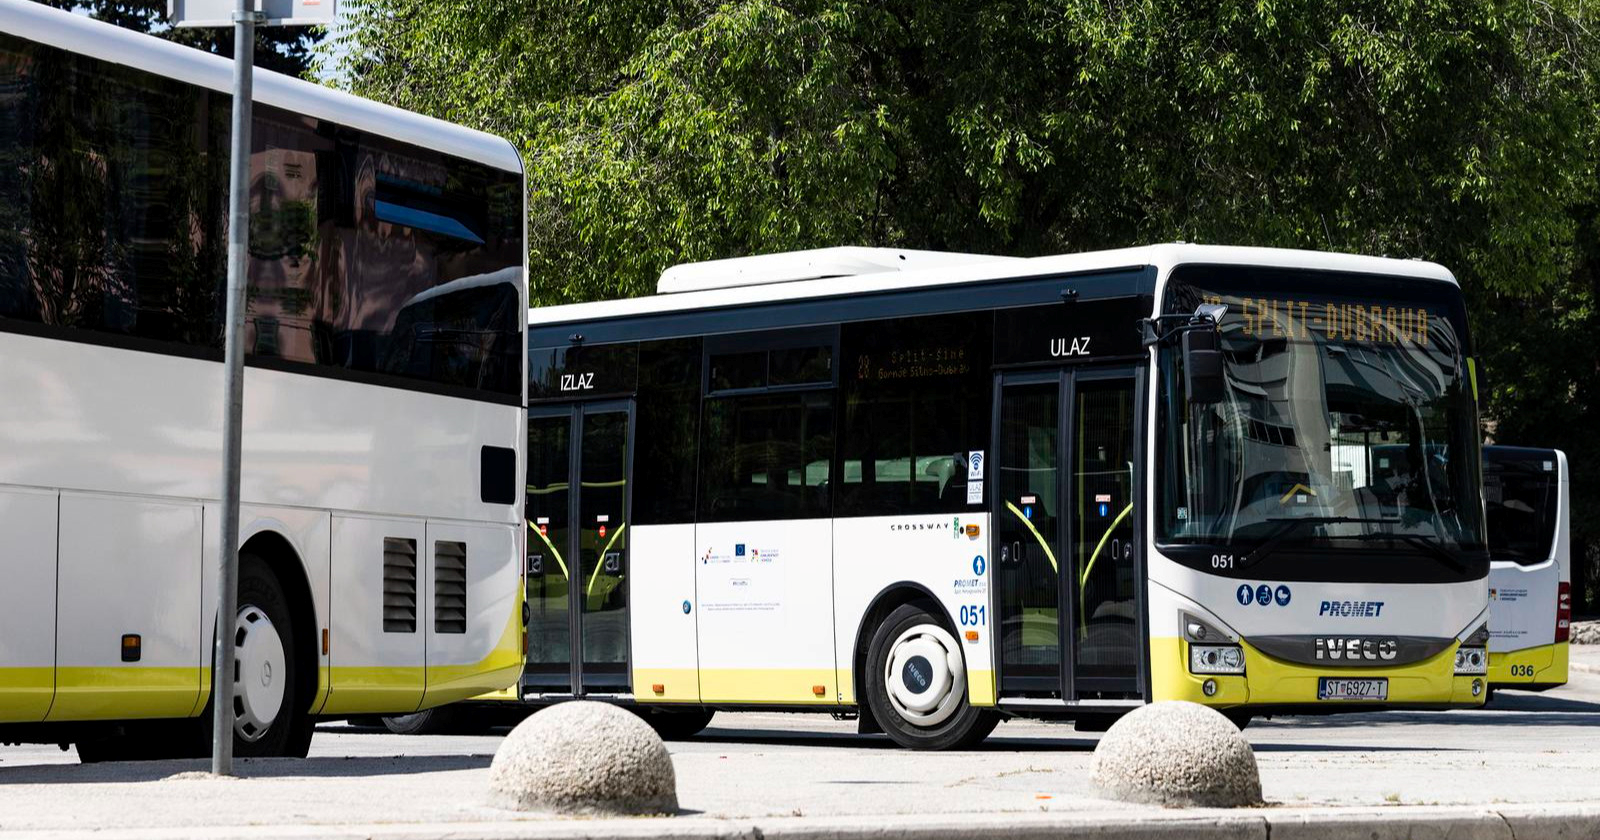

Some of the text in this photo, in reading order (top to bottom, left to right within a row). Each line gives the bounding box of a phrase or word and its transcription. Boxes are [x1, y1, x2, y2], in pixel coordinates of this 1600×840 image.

[1242, 296, 1429, 345] SPLIT-DUBRAVA
[1050, 336, 1091, 357] ULAZ
[560, 372, 594, 390] IZLAZ
[891, 522, 949, 531] CROSSWAY
[1211, 554, 1234, 569] 051
[953, 578, 979, 588] PROMET
[960, 605, 986, 626] 051
[1319, 600, 1385, 617] PROMET
[1315, 638, 1397, 660] IVECO
[907, 662, 927, 687] IVECO
[1510, 664, 1534, 677] 036
